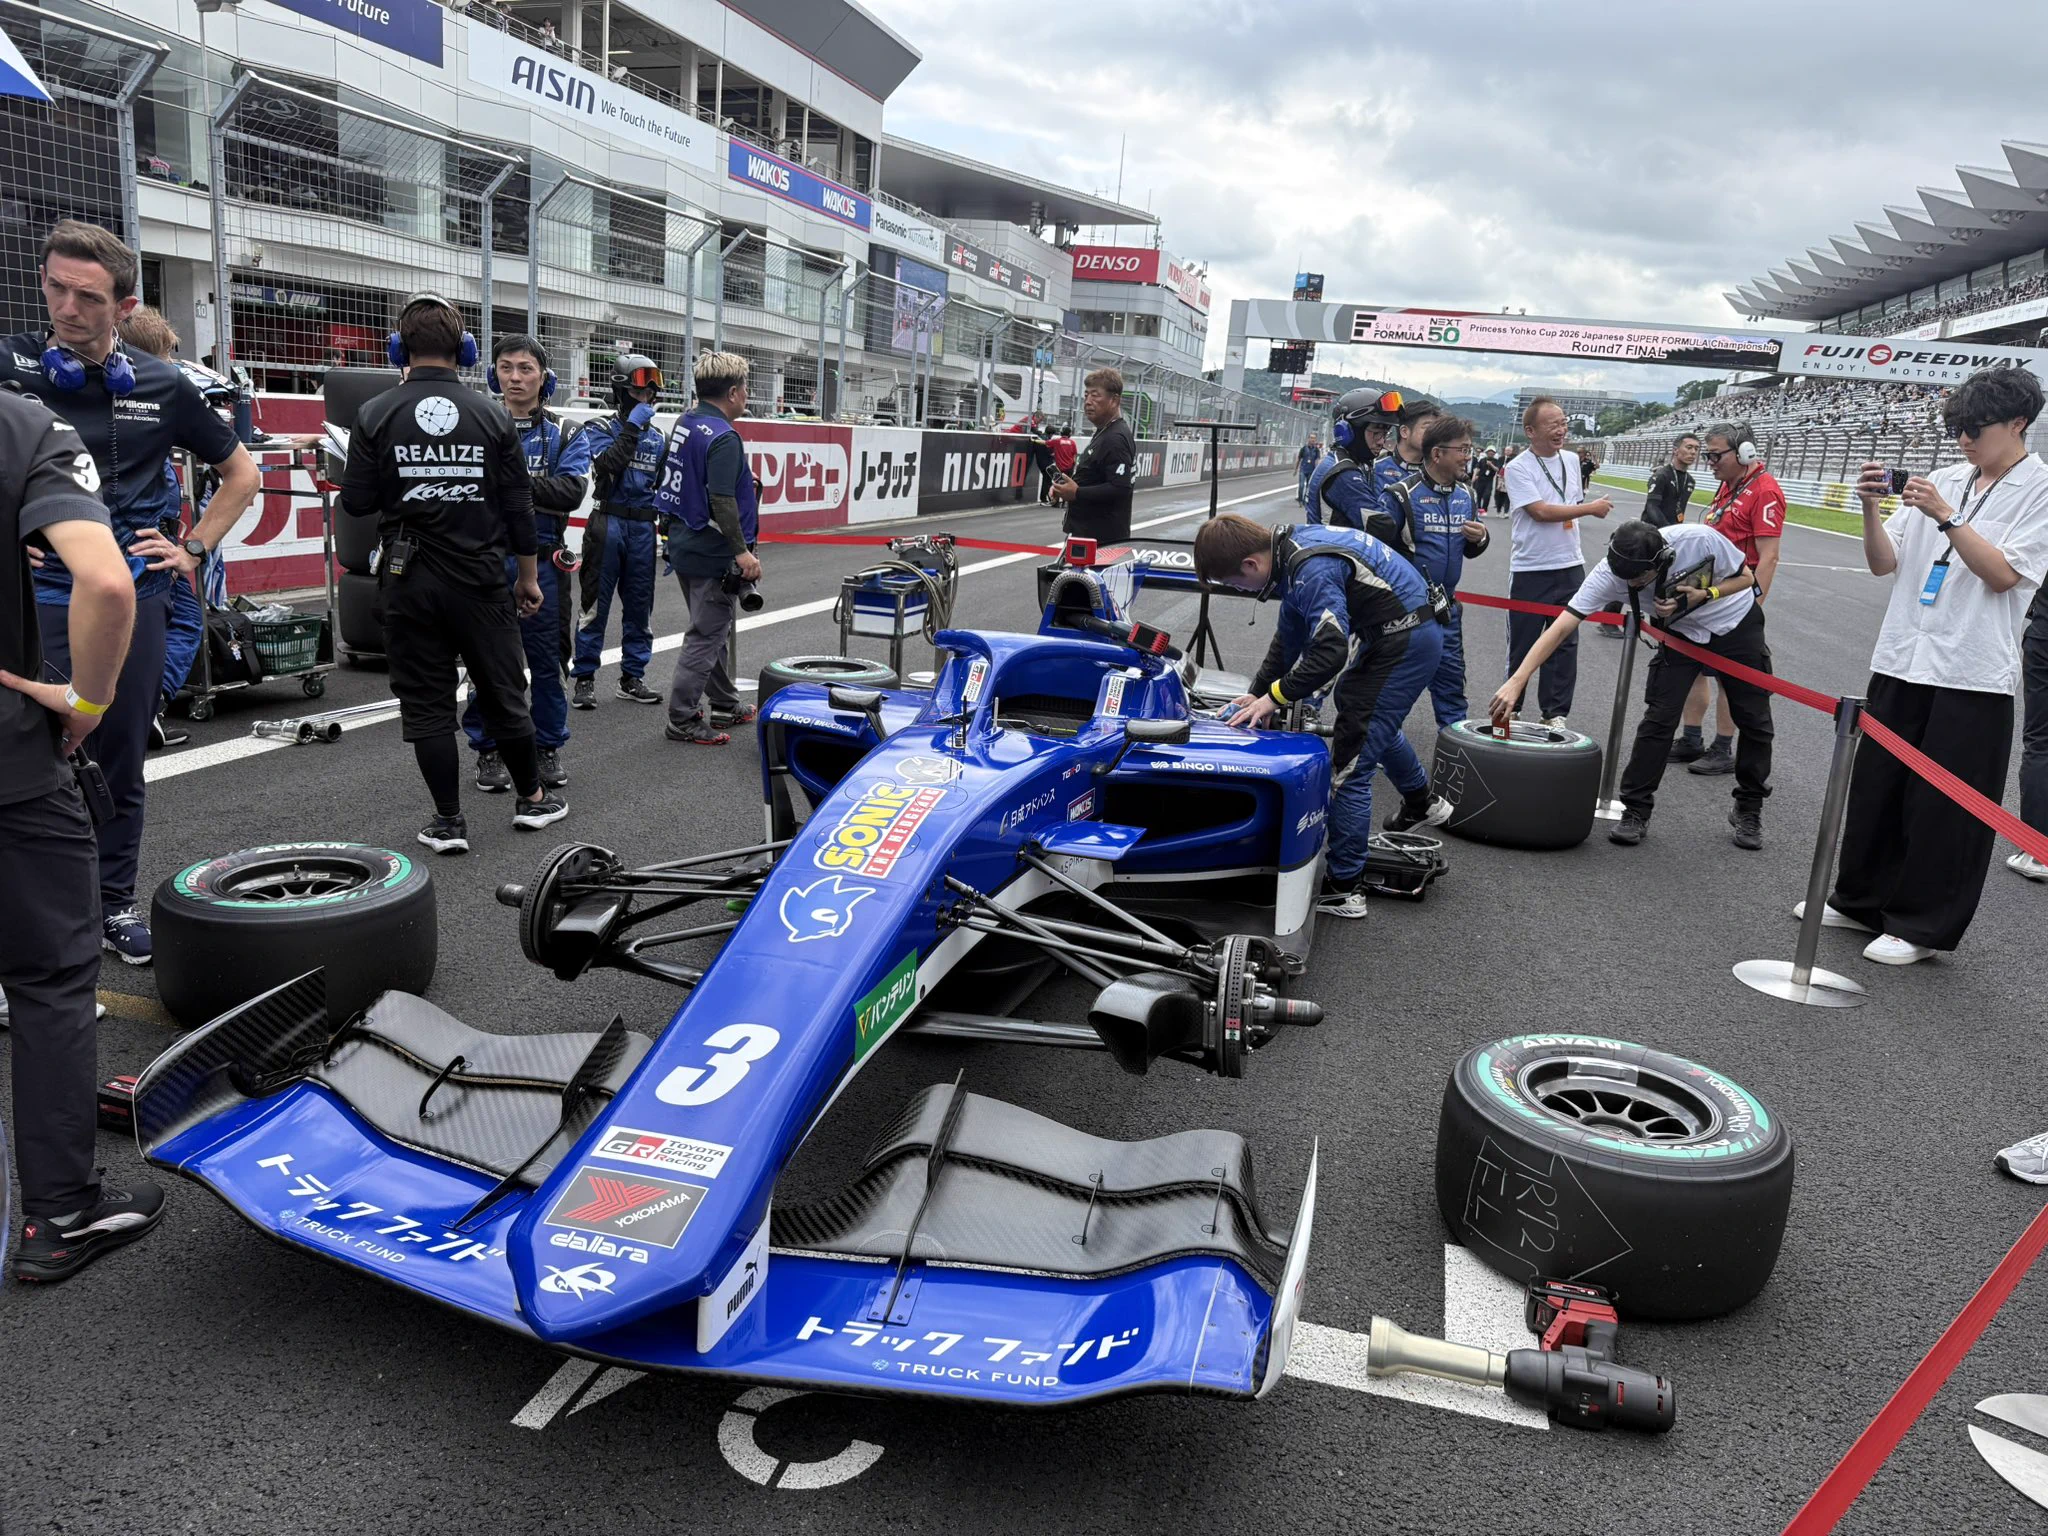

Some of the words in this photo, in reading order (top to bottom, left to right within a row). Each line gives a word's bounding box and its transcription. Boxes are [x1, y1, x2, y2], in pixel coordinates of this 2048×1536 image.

[511, 55, 596, 115] AISIN
[601, 98, 616, 118] We
[619, 106, 646, 130] Touch
[648, 119, 663, 137] the
[664, 126, 691, 148] Future
[875, 213, 908, 239] Panasonic
[1075, 253, 1141, 272] DENSO
[1375, 322, 1425, 332] SUPER
[1429, 317, 1462, 327] NEXT
[1374, 330, 1424, 342] FORMULA
[1428, 326, 1461, 344] 50
[1469, 324, 1507, 334] Princess
[1510, 326, 1537, 336] Yohko
[1539, 328, 1557, 338] Cup
[1559, 329, 1580, 338] 2026
[1581, 331, 1625, 342] Japanese
[1627, 333, 1659, 344] SUPER
[1661, 336, 1709, 347] FORMULA
[1710, 339, 1779, 354] Championship
[1572, 341, 1622, 355] Round7
[1626, 345, 1666, 358] FINAL
[1804, 344, 1867, 359] FUJI
[1867, 343, 2033, 369] SPEEDWAY
[1802, 361, 1866, 373] ENJOY!
[114, 399, 160, 410] Williams
[133, 415, 160, 423] Academy
[394, 445, 485, 463] REALIZE
[634, 451, 657, 463] LIZE
[72, 453, 101, 493] 3
[411, 467, 472, 476] GROUP
[1115, 463, 1126, 476] 4
[1131, 549, 1196, 567] YOKO
[782, 713, 811, 724] BINGO
[1172, 761, 1215, 771] BINGO
[823, 785, 917, 869] SONIC
[867, 848, 894, 874] THE
[888, 789, 941, 843] HEDGEHOG
[256, 843, 349, 854] ADVAN
[871, 968, 915, 1030] バンテリン
[1521, 1037, 1622, 1051] ADVAN
[655, 1023, 781, 1106] 3
[1705, 1075, 1752, 1116] YOKOHAMA
[600, 1139, 657, 1159] GR
[660, 1147, 714, 1163] GAZOO
[669, 1140, 725, 1157] TOYOTA
[653, 1154, 707, 1171] Racing
[256, 1153, 384, 1220] トラック
[375, 1215, 506, 1262] ファンド
[614, 1192, 692, 1228] YOKOHAMA
[296, 1216, 352, 1244] TRUCK
[354, 1240, 406, 1263] FUND
[550, 1230, 649, 1264] dallara
[726, 1271, 755, 1320] PUMA
[795, 1316, 965, 1356] トラック
[983, 1327, 1140, 1366] ファンド
[896, 1361, 980, 1380] TRUCK
[991, 1372, 1060, 1387] FUND
